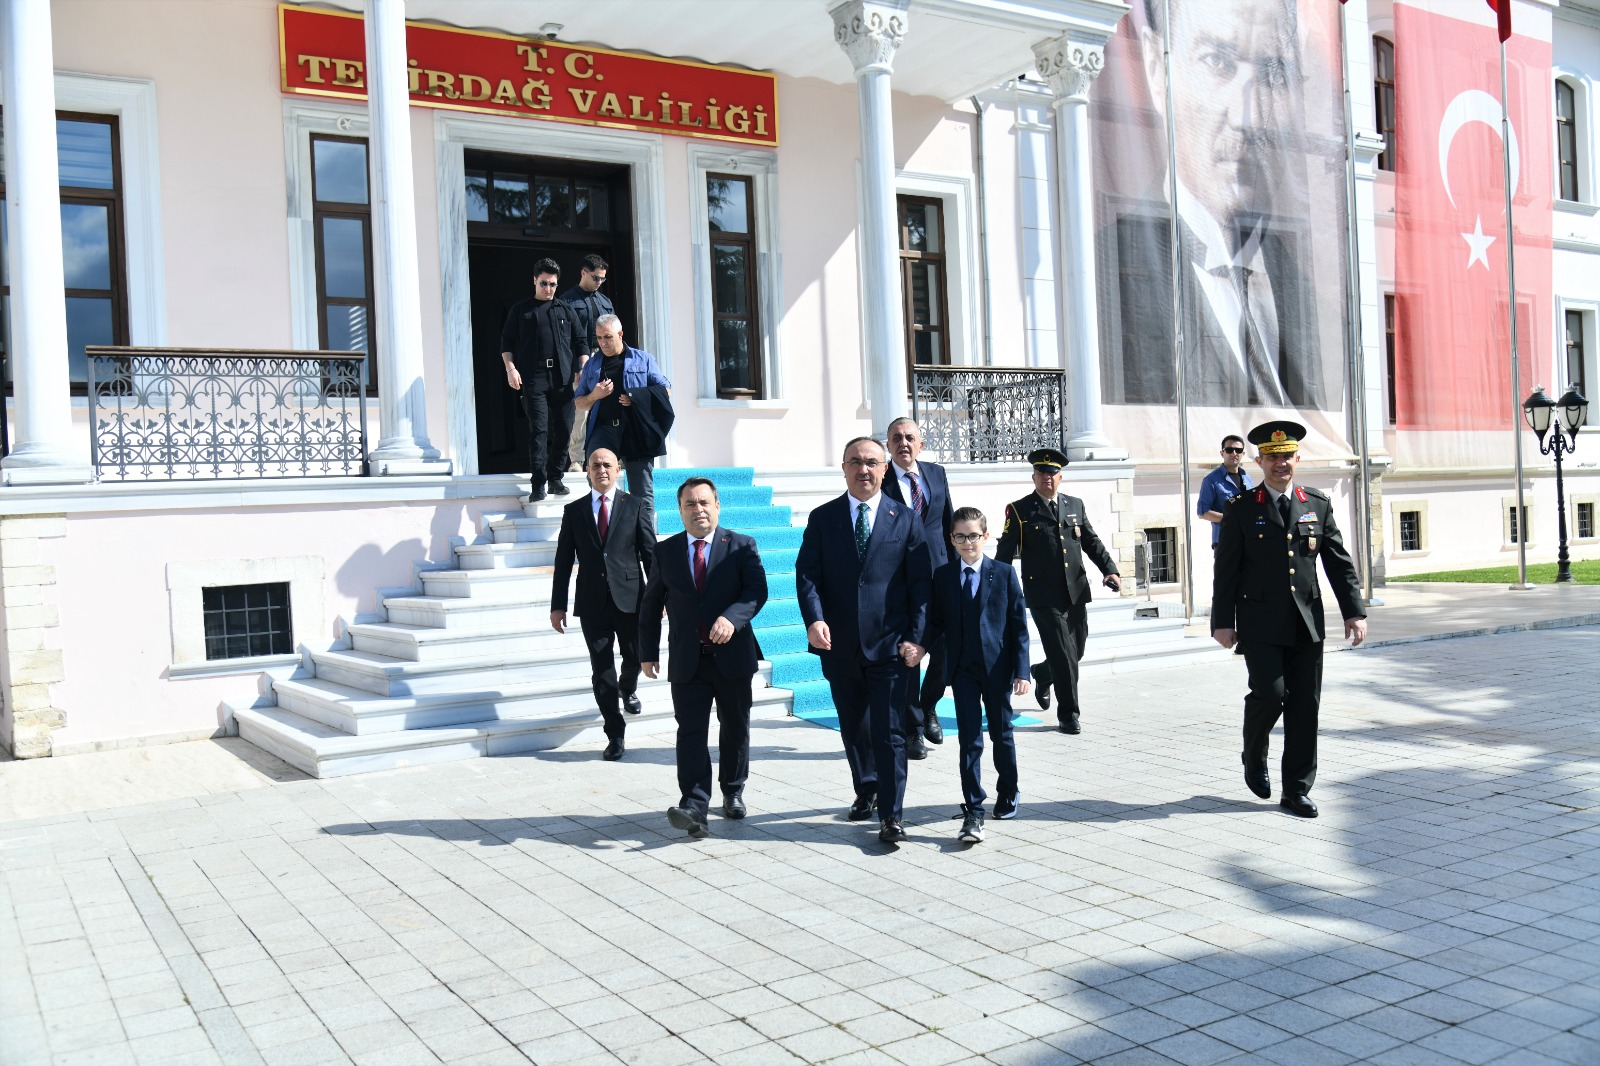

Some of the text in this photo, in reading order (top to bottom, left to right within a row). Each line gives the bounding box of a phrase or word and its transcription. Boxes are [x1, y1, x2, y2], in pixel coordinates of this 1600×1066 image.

[517, 44, 604, 80] T. C.
[298, 54, 769, 136] TEİRDAĞ VALİLİĞİ
